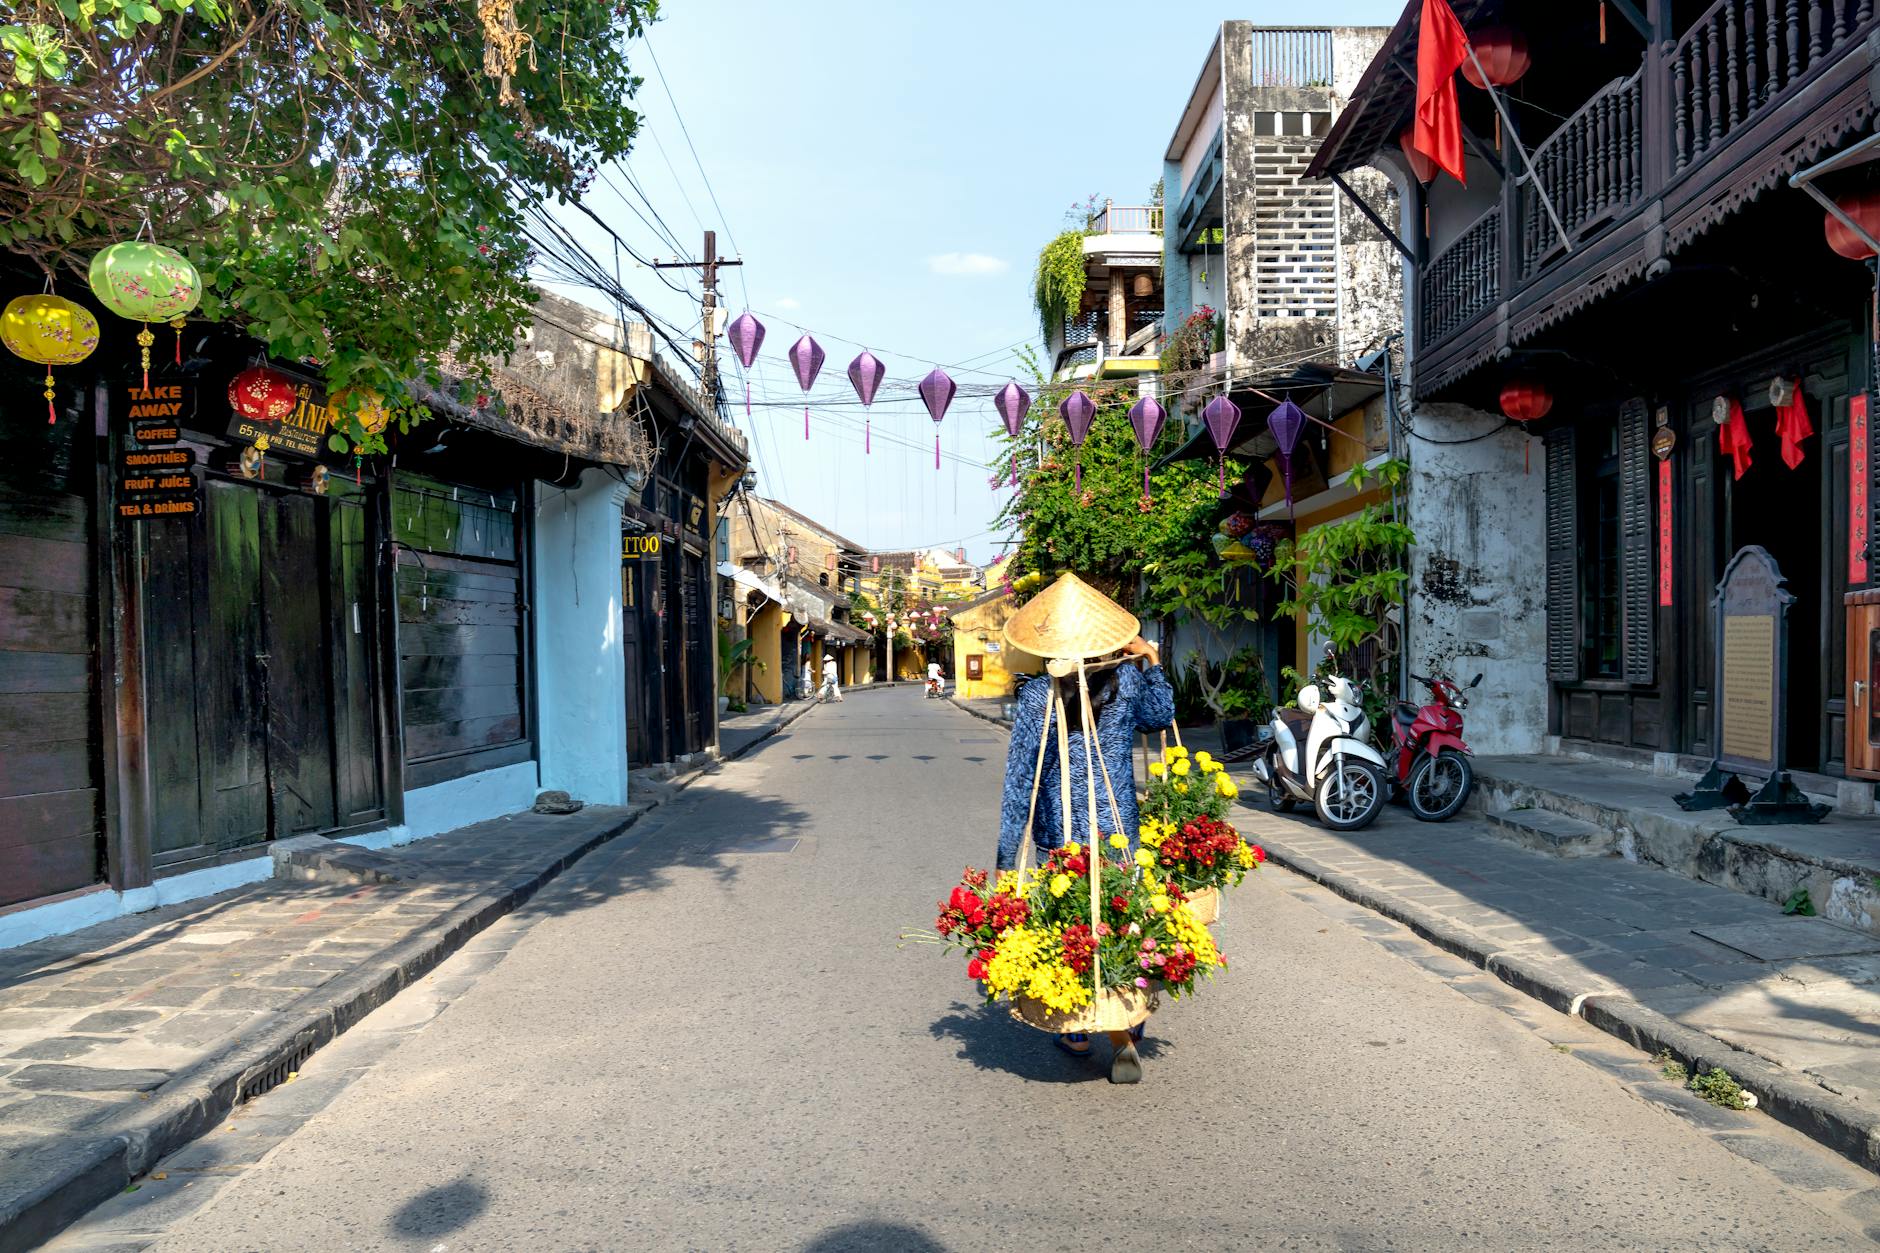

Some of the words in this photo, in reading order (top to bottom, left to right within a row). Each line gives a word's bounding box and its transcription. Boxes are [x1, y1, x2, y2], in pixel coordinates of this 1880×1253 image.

[128, 386, 182, 400] TAKE
[128, 403, 183, 418] AWAY
[136, 428, 177, 440] COFFEE
[239, 424, 254, 437] 65
[120, 505, 141, 516] TEA
[142, 503, 153, 515] &
[622, 536, 659, 553] TTOO
